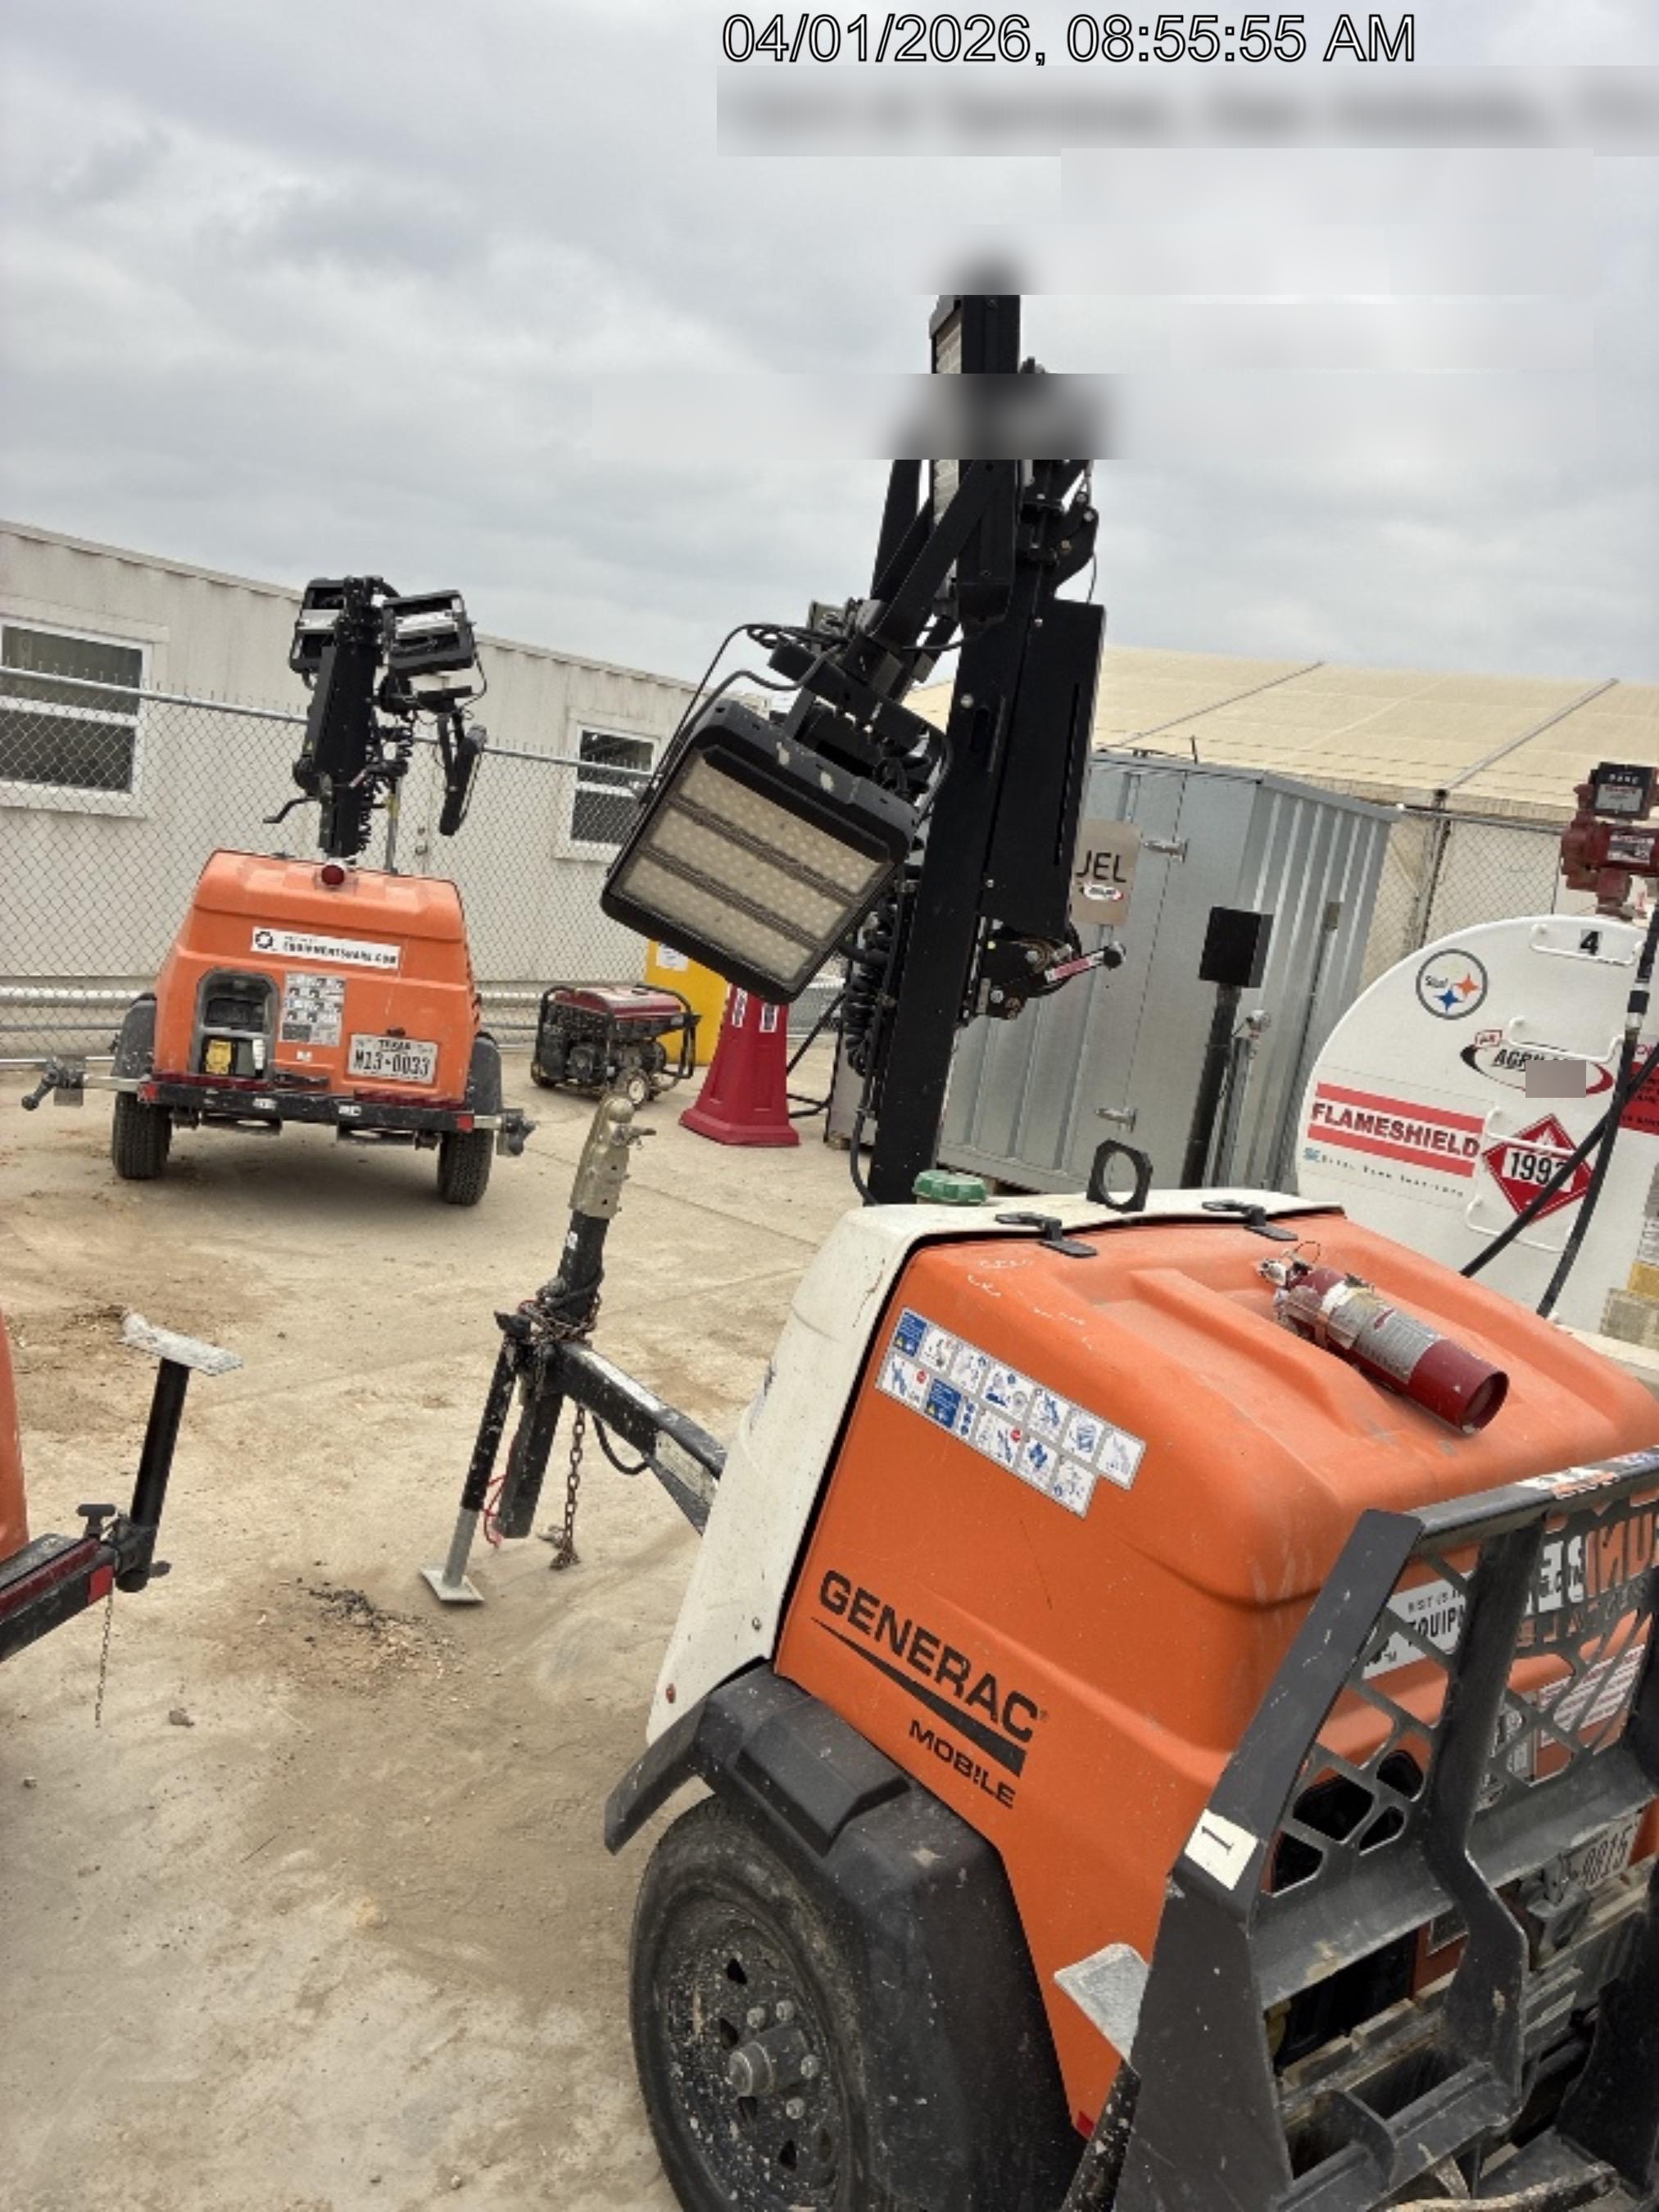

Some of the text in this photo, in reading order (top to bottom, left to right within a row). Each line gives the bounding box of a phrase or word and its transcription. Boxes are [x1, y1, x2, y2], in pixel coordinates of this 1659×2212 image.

[1580, 930, 1599, 957] 4
[1311, 1102, 1481, 1158] FLAMESHIELD
[819, 1569, 1039, 1743] GENERAC
[909, 1719, 1017, 1810] MOBILE
